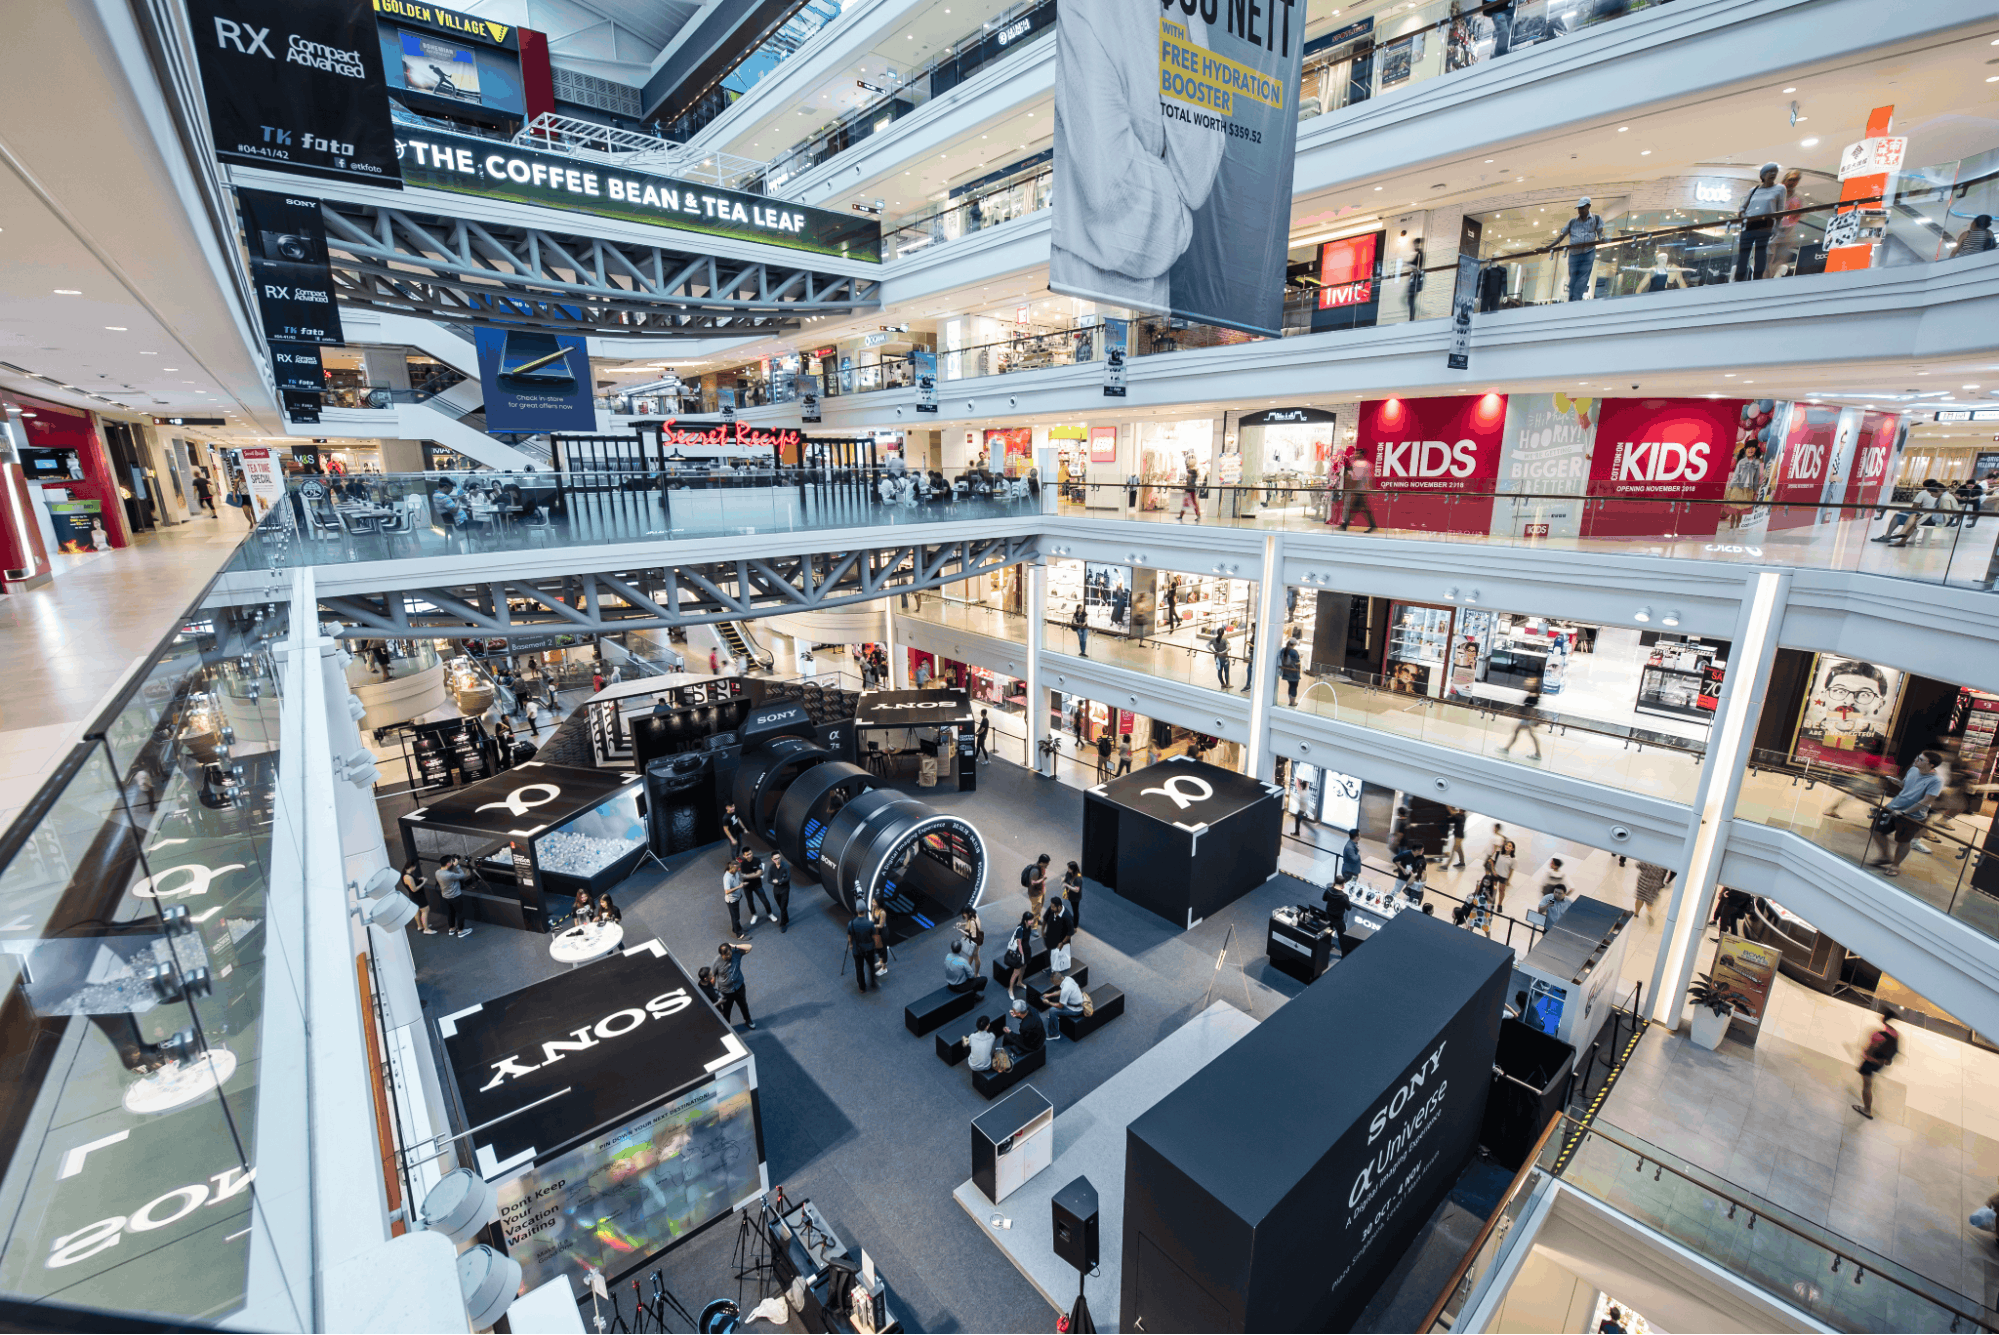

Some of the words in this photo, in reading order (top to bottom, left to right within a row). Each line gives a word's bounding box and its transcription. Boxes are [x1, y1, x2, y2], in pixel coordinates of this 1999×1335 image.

[382, 0, 432, 22] GOLDEN
[434, 8, 487, 37] VILLAGE
[1162, 20, 1184, 40] WITH
[213, 16, 276, 60] RX
[288, 34, 360, 64] Compact
[286, 47, 366, 78] Advanced
[1162, 40, 1199, 74] FREE
[1202, 56, 1280, 104] HYDRATION
[1162, 69, 1230, 112] BOOSTER
[1160, 102, 1192, 124] TOTAL
[1194, 112, 1226, 134] WORTH
[1229, 122, 1262, 144] $359.52
[238, 144, 290, 160] #04-41/42
[260, 126, 292, 146] TK
[301, 132, 354, 156] foto
[350, 162, 382, 173] @tkfoto
[409, 140, 475, 174] THE
[486, 154, 599, 196] COFFEE
[608, 176, 679, 211] BEAN
[684, 192, 702, 214] &
[702, 196, 749, 224] TEA
[754, 206, 806, 234] LEAF
[286, 198, 316, 208] SONY
[264, 284, 290, 300] RX
[294, 288, 326, 297] Compact
[294, 294, 328, 304] Advanced
[276, 354, 292, 363] RX
[662, 417, 730, 447] Secret
[734, 420, 800, 455] Recipe
[1520, 424, 1581, 449] HOORAY!
[294, 454, 315, 464] M&S
[1382, 438, 1478, 478] KIDS
[1544, 446, 1572, 457] GETTING
[1619, 442, 1710, 482] KIDS
[1790, 444, 1825, 479] KIDS
[1866, 447, 1886, 477] KIDS
[247, 464, 256, 473] TEA
[251, 474, 272, 484] SPECIAL
[1511, 456, 1582, 478] BIGGER
[1525, 479, 1577, 494] BETTER!
[512, 641, 546, 650] Basement
[757, 709, 797, 724] SONY
[870, 702, 958, 710] SONY
[884, 850, 898, 870] Digital
[897, 832, 918, 851] Imaging
[918, 822, 946, 834] Experience
[821, 854, 837, 870] SONY
[479, 987, 692, 1093] SONY
[1367, 1040, 1447, 1146] SONY
[599, 1141, 611, 1150] PIN
[612, 1130, 632, 1144] DOWN
[634, 1120, 652, 1132] YOUR
[652, 1113, 668, 1123] NEXT
[670, 1092, 710, 1115] DESTINATION!
[1377, 1080, 1447, 1174] Universe
[1345, 1217, 1352, 1230] A
[1354, 1184, 1378, 1220] Digital
[1380, 1151, 1408, 1188] Imaging
[1408, 1109, 1442, 1153] Experience
[535, 1179, 565, 1199] Keep
[1361, 1222, 1372, 1242] 30
[1374, 1198, 1392, 1225] OCT
[1404, 1160, 1422, 1187] NOV
[503, 1207, 532, 1225] Your
[505, 1205, 559, 1236] Vacation
[508, 1218, 555, 1246] Waiting
[559, 1242, 573, 1252] One
[1332, 1265, 1350, 1292] Plaza
